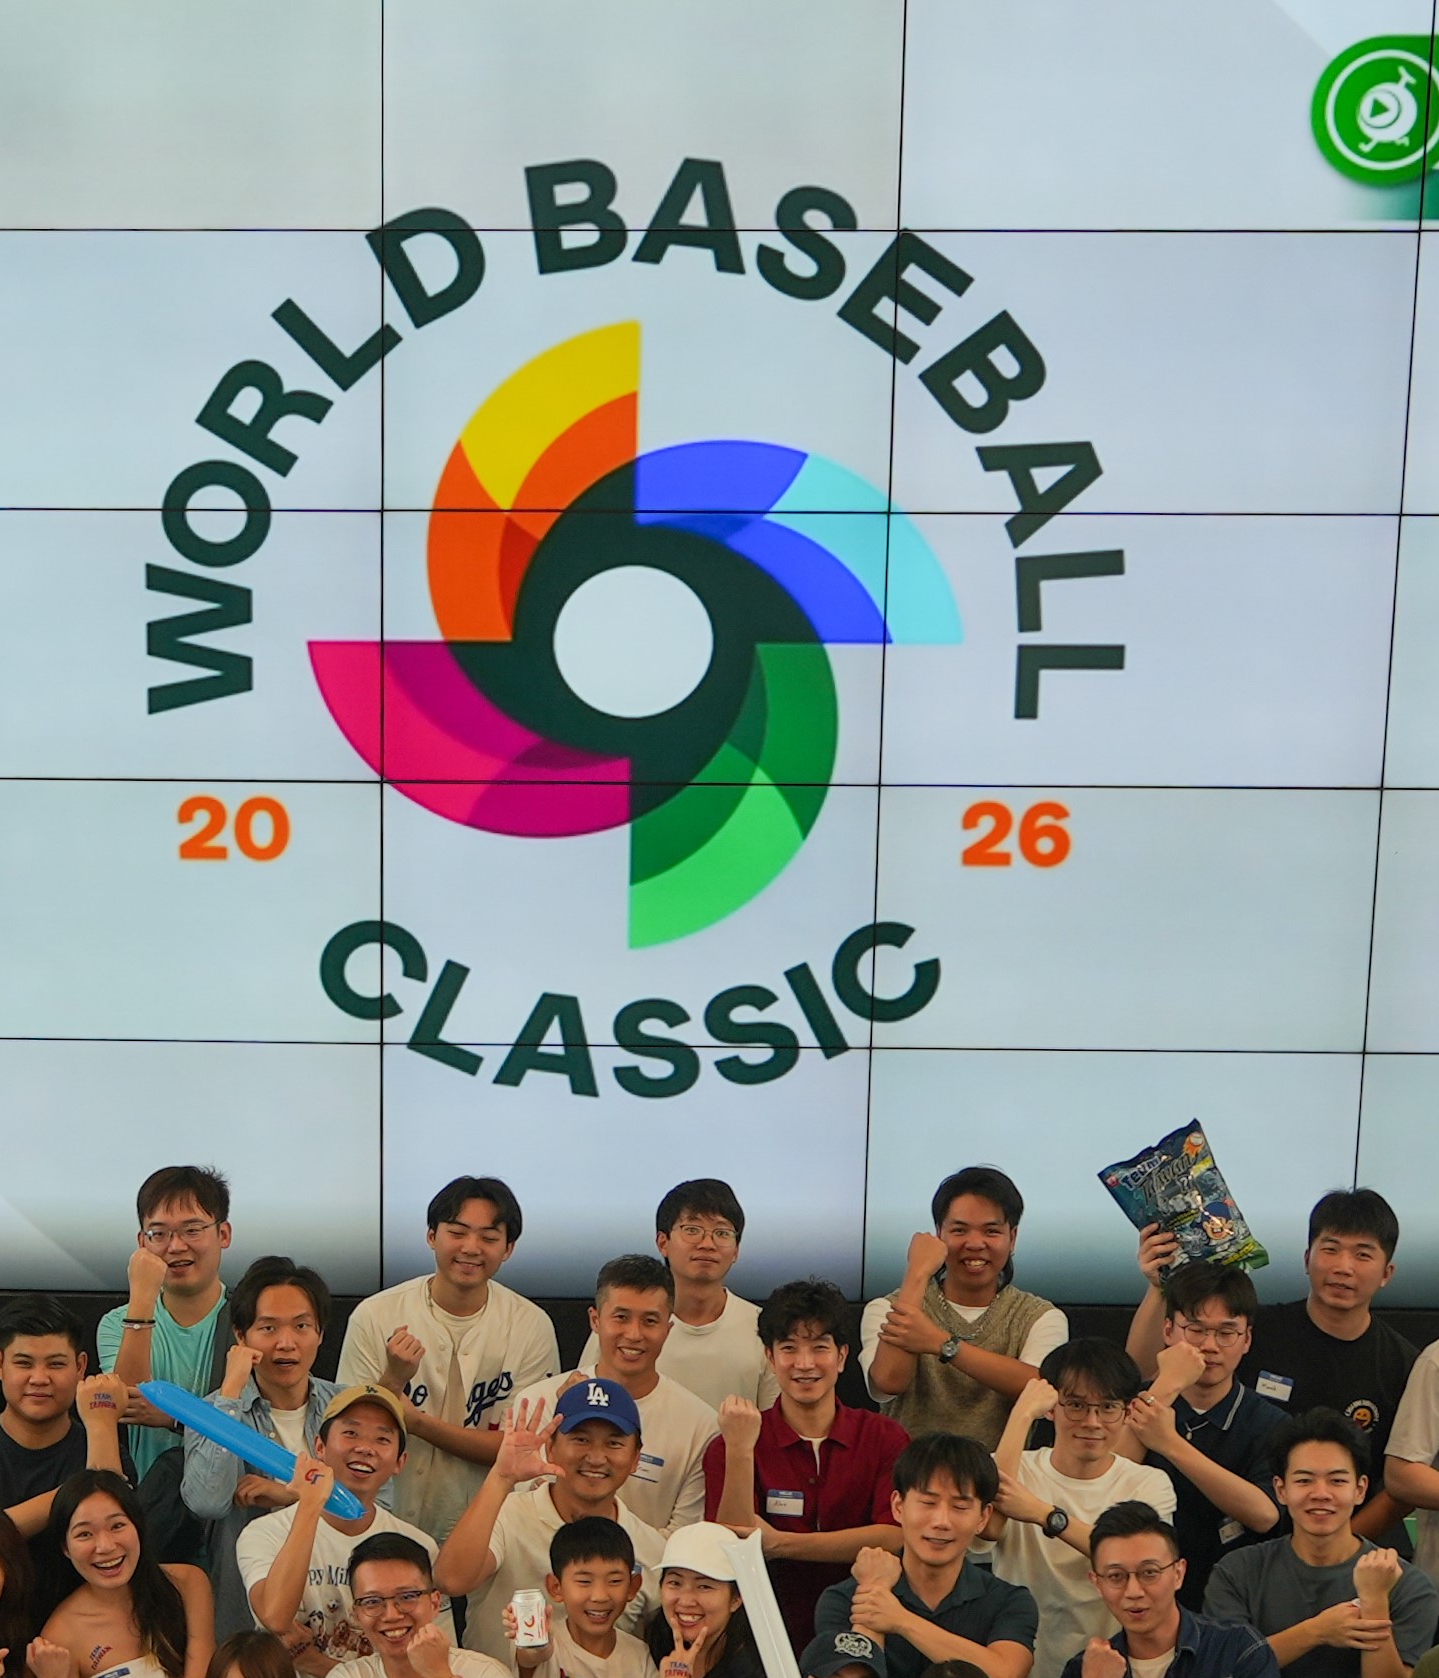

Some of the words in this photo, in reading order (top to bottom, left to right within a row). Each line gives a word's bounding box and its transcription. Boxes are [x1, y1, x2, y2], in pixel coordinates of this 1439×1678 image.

[143, 205, 486, 715] WORLD
[523, 156, 1127, 721] BASEBALL
[175, 795, 291, 861] 20
[960, 800, 1073, 867] 26
[318, 918, 942, 1099] CLASSIC
[587, 1382, 610, 1407] LA
